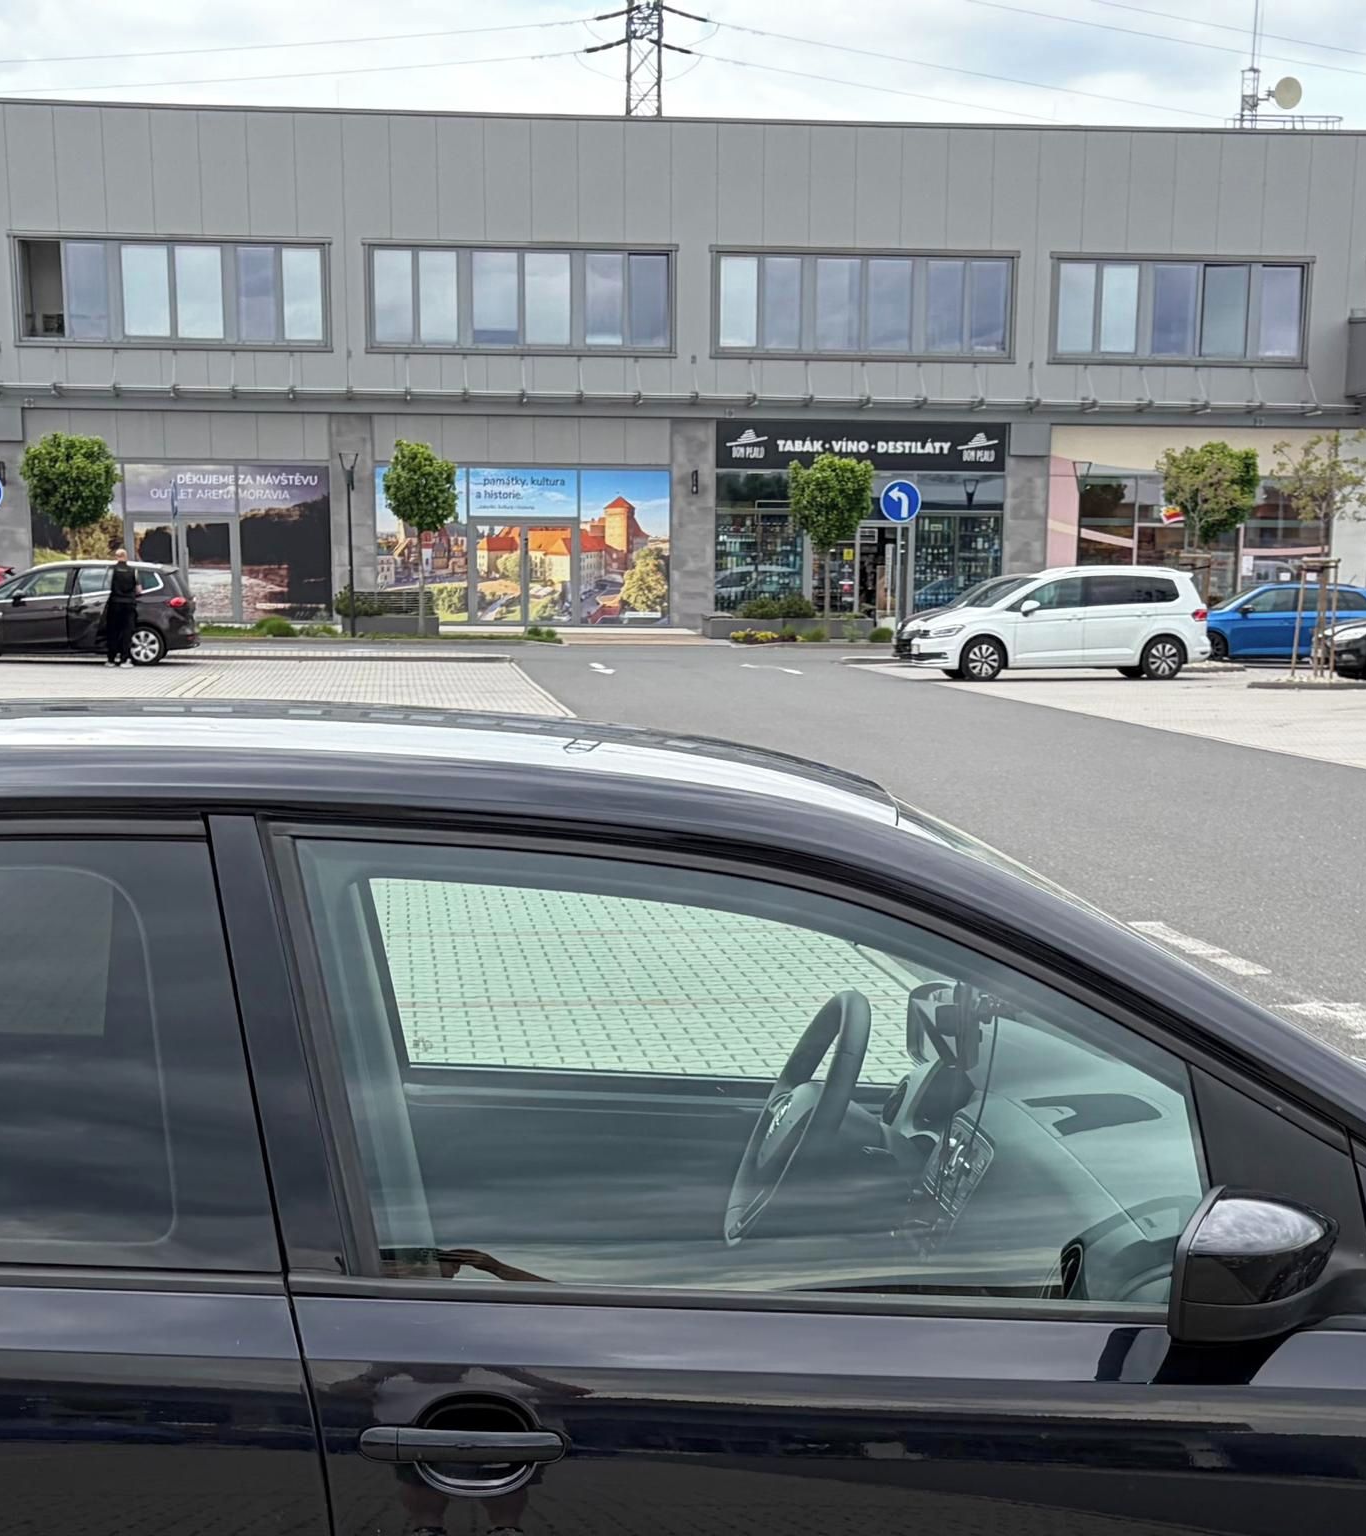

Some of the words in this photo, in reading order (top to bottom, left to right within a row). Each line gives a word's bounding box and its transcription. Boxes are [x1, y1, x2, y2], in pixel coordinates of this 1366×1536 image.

[776, 436, 824, 453] TABÁK
[831, 436, 870, 454] VÍNO
[876, 438, 952, 455] DESTILÁTY
[177, 472, 235, 486] DĚKUJEME
[238, 474, 253, 486] ZA
[256, 472, 318, 486] NÁVŠTĚVU
[531, 476, 566, 487] kultura
[196, 488, 235, 500] ARENA
[238, 488, 291, 500] MORAVIA
[475, 490, 482, 500] a
